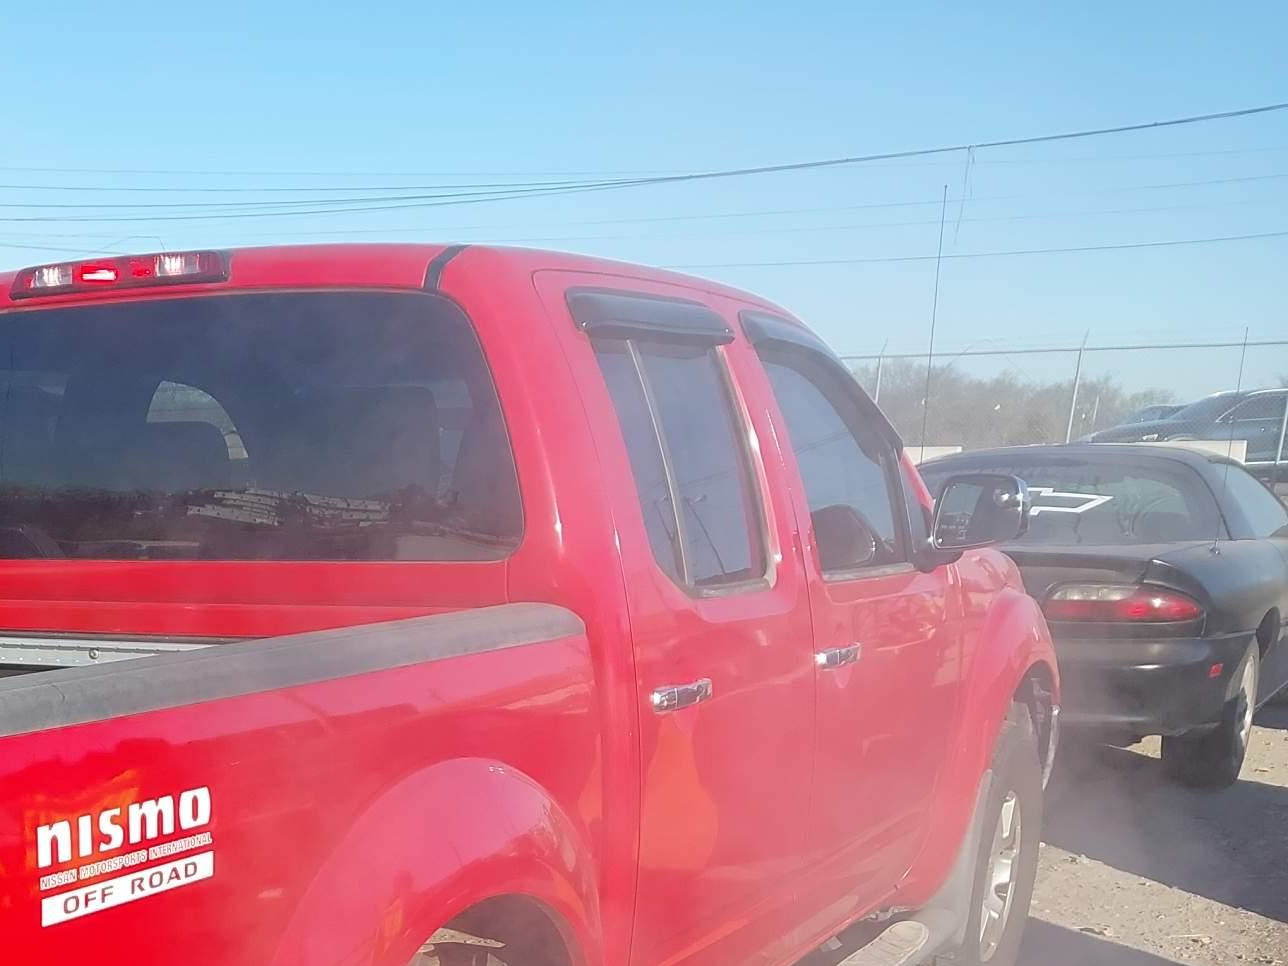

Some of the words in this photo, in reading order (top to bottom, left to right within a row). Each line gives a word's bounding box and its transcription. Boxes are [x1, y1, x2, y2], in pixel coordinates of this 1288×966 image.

[40, 869, 78, 890] NISSAN
[80, 850, 147, 880] MOTORSPORTS
[149, 832, 213, 860] INTERNATIONAL
[63, 886, 114, 914] OFF
[131, 861, 198, 894] ROAD
